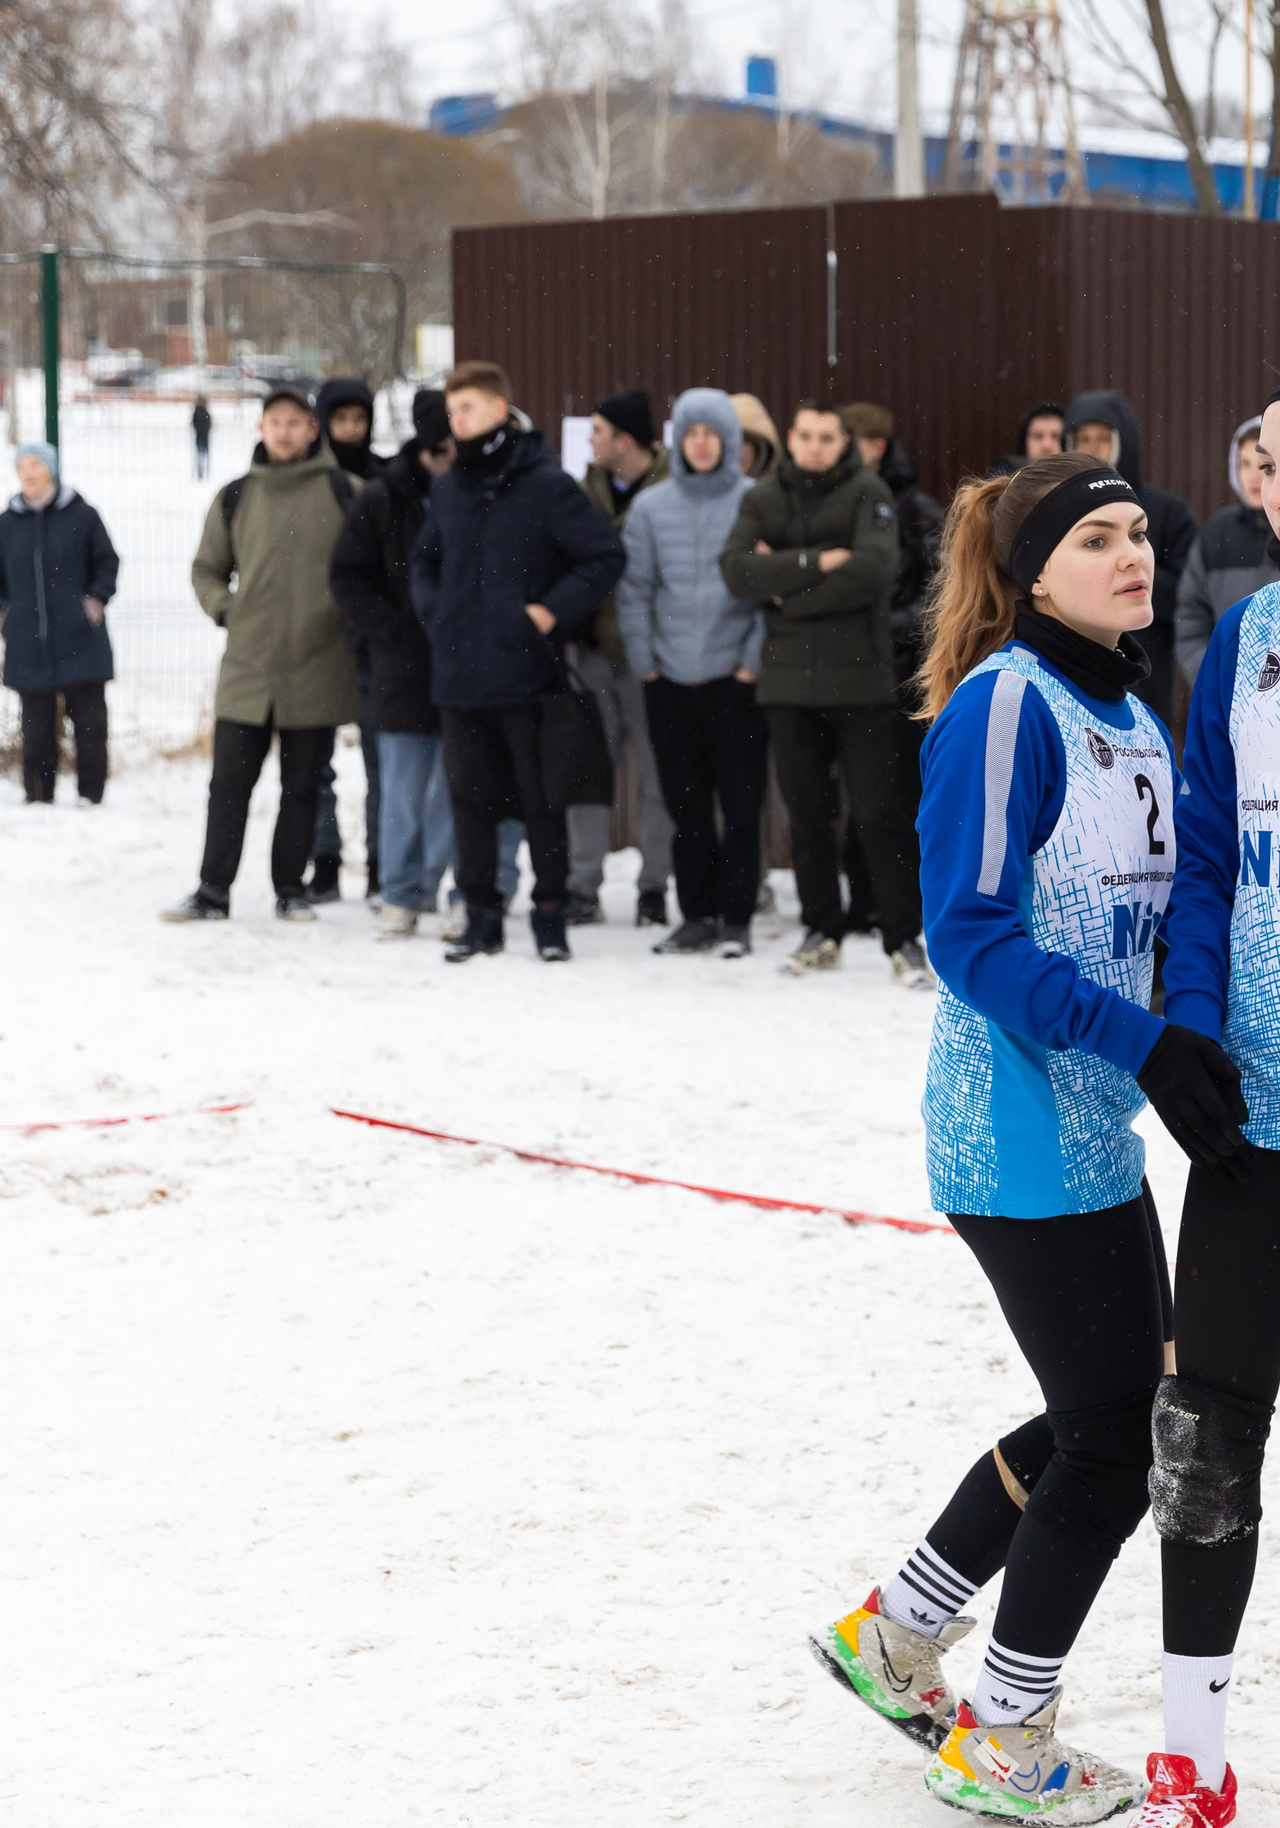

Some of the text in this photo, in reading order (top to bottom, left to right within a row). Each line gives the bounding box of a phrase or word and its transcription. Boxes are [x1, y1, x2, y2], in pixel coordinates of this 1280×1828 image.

[1133, 773, 1166, 855] 2
[1101, 871, 1149, 887] ФЕДЕРЦИЯ
[1164, 1401, 1200, 1421] Larsen
